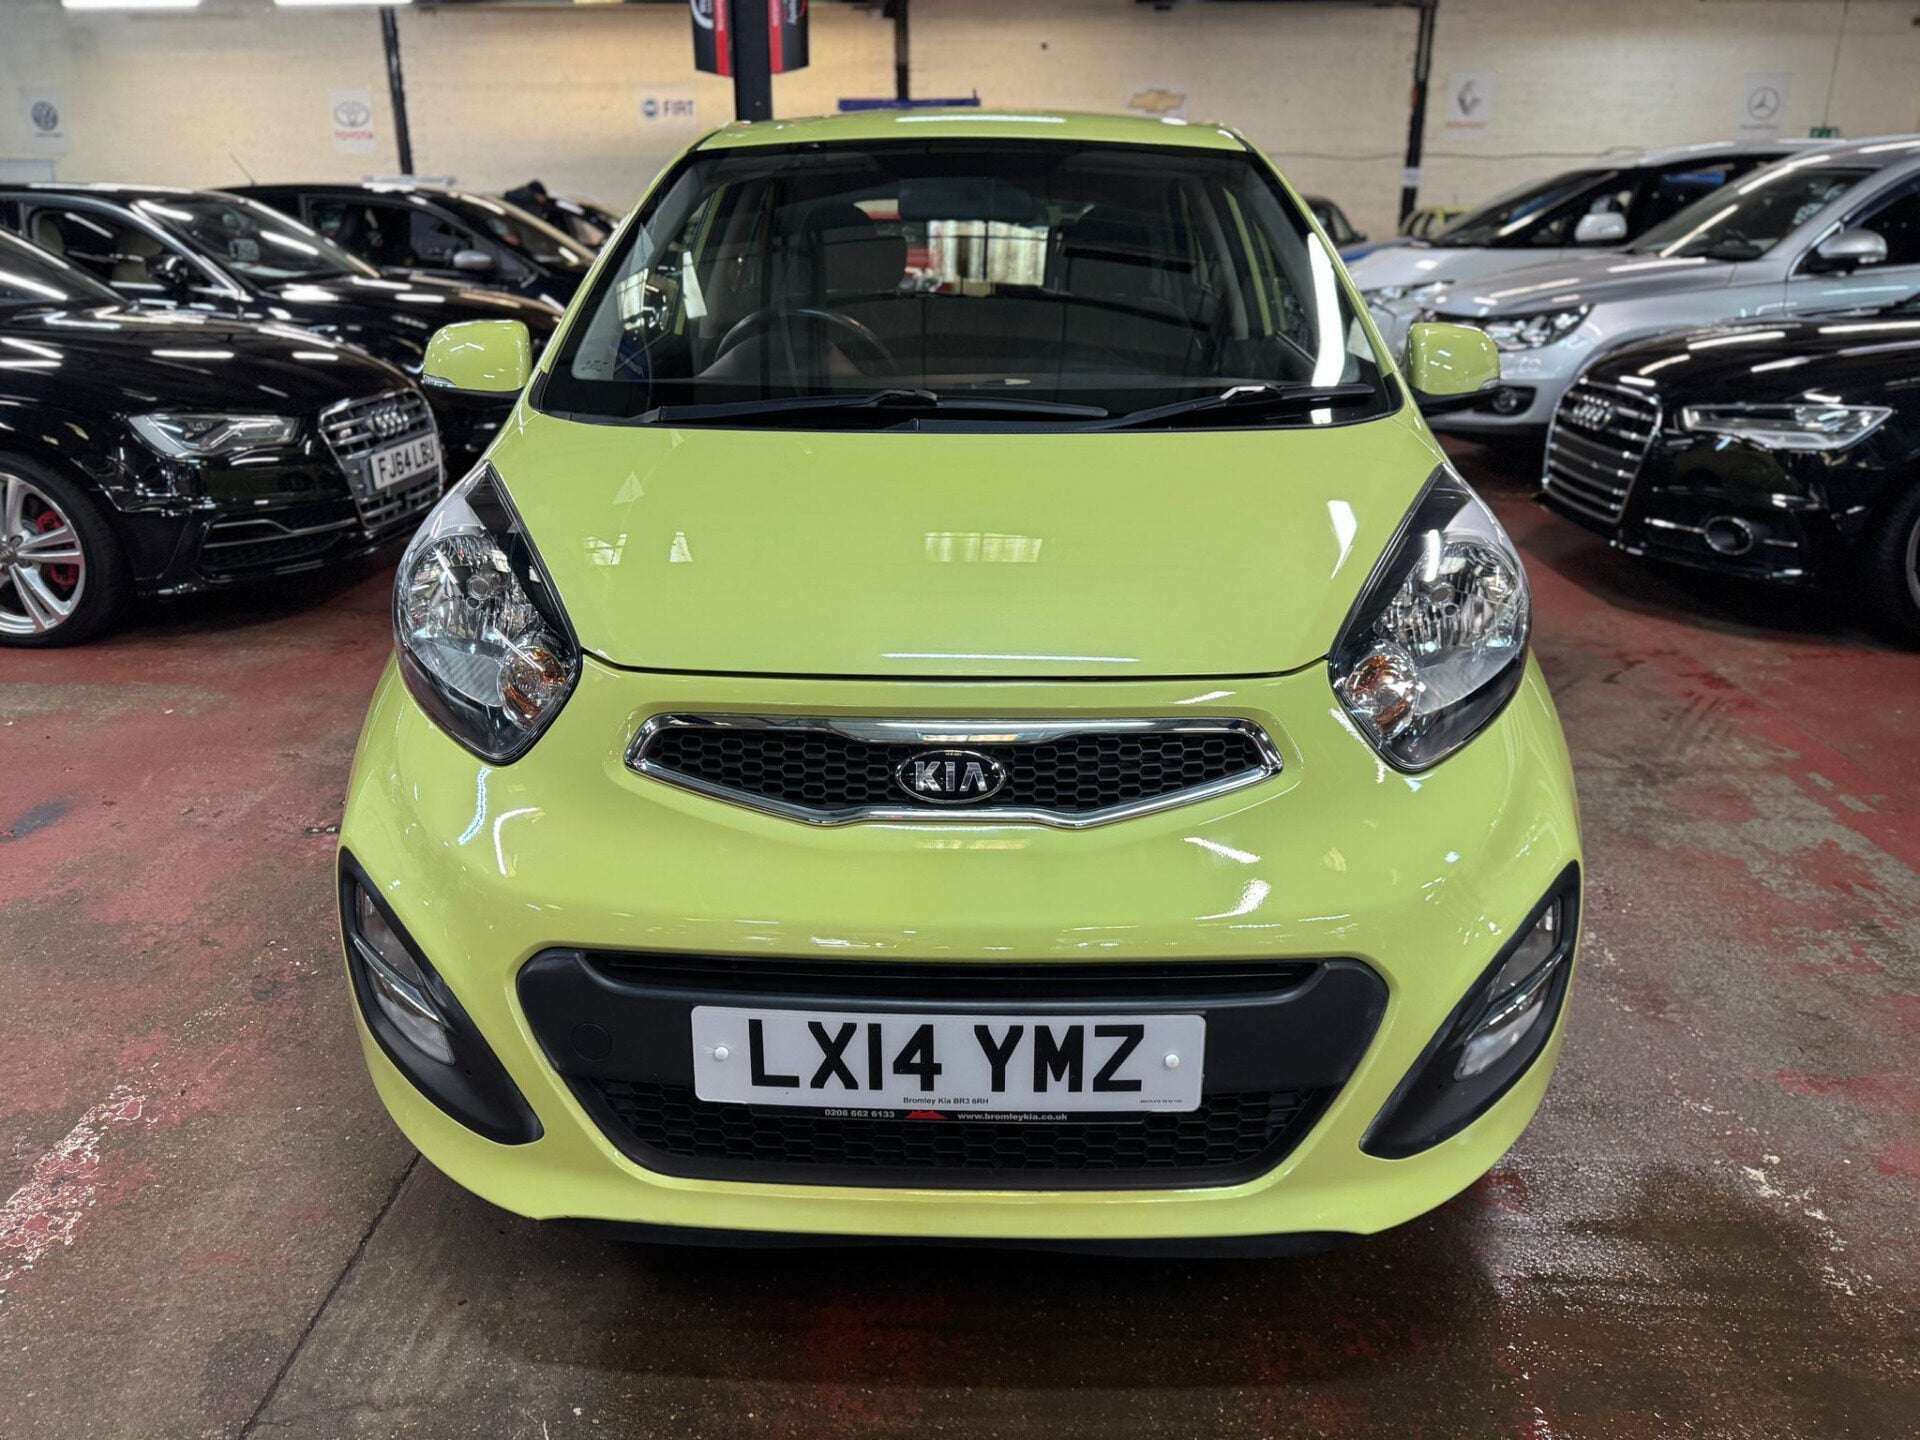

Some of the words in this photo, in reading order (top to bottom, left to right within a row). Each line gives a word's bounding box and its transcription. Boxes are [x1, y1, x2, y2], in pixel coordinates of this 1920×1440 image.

[377, 446, 412, 482] FJ64
[915, 761, 988, 792] KIA
[748, 1018, 943, 1092] LX14
[973, 1023, 1145, 1093] YMZ
[903, 1096, 936, 1106] Bromley
[938, 1097, 951, 1105] Kia
[953, 1097, 970, 1105] BR3
[871, 1110, 895, 1119] 6133
[957, 1112, 1068, 1121] www.bromleykia.co.uk
